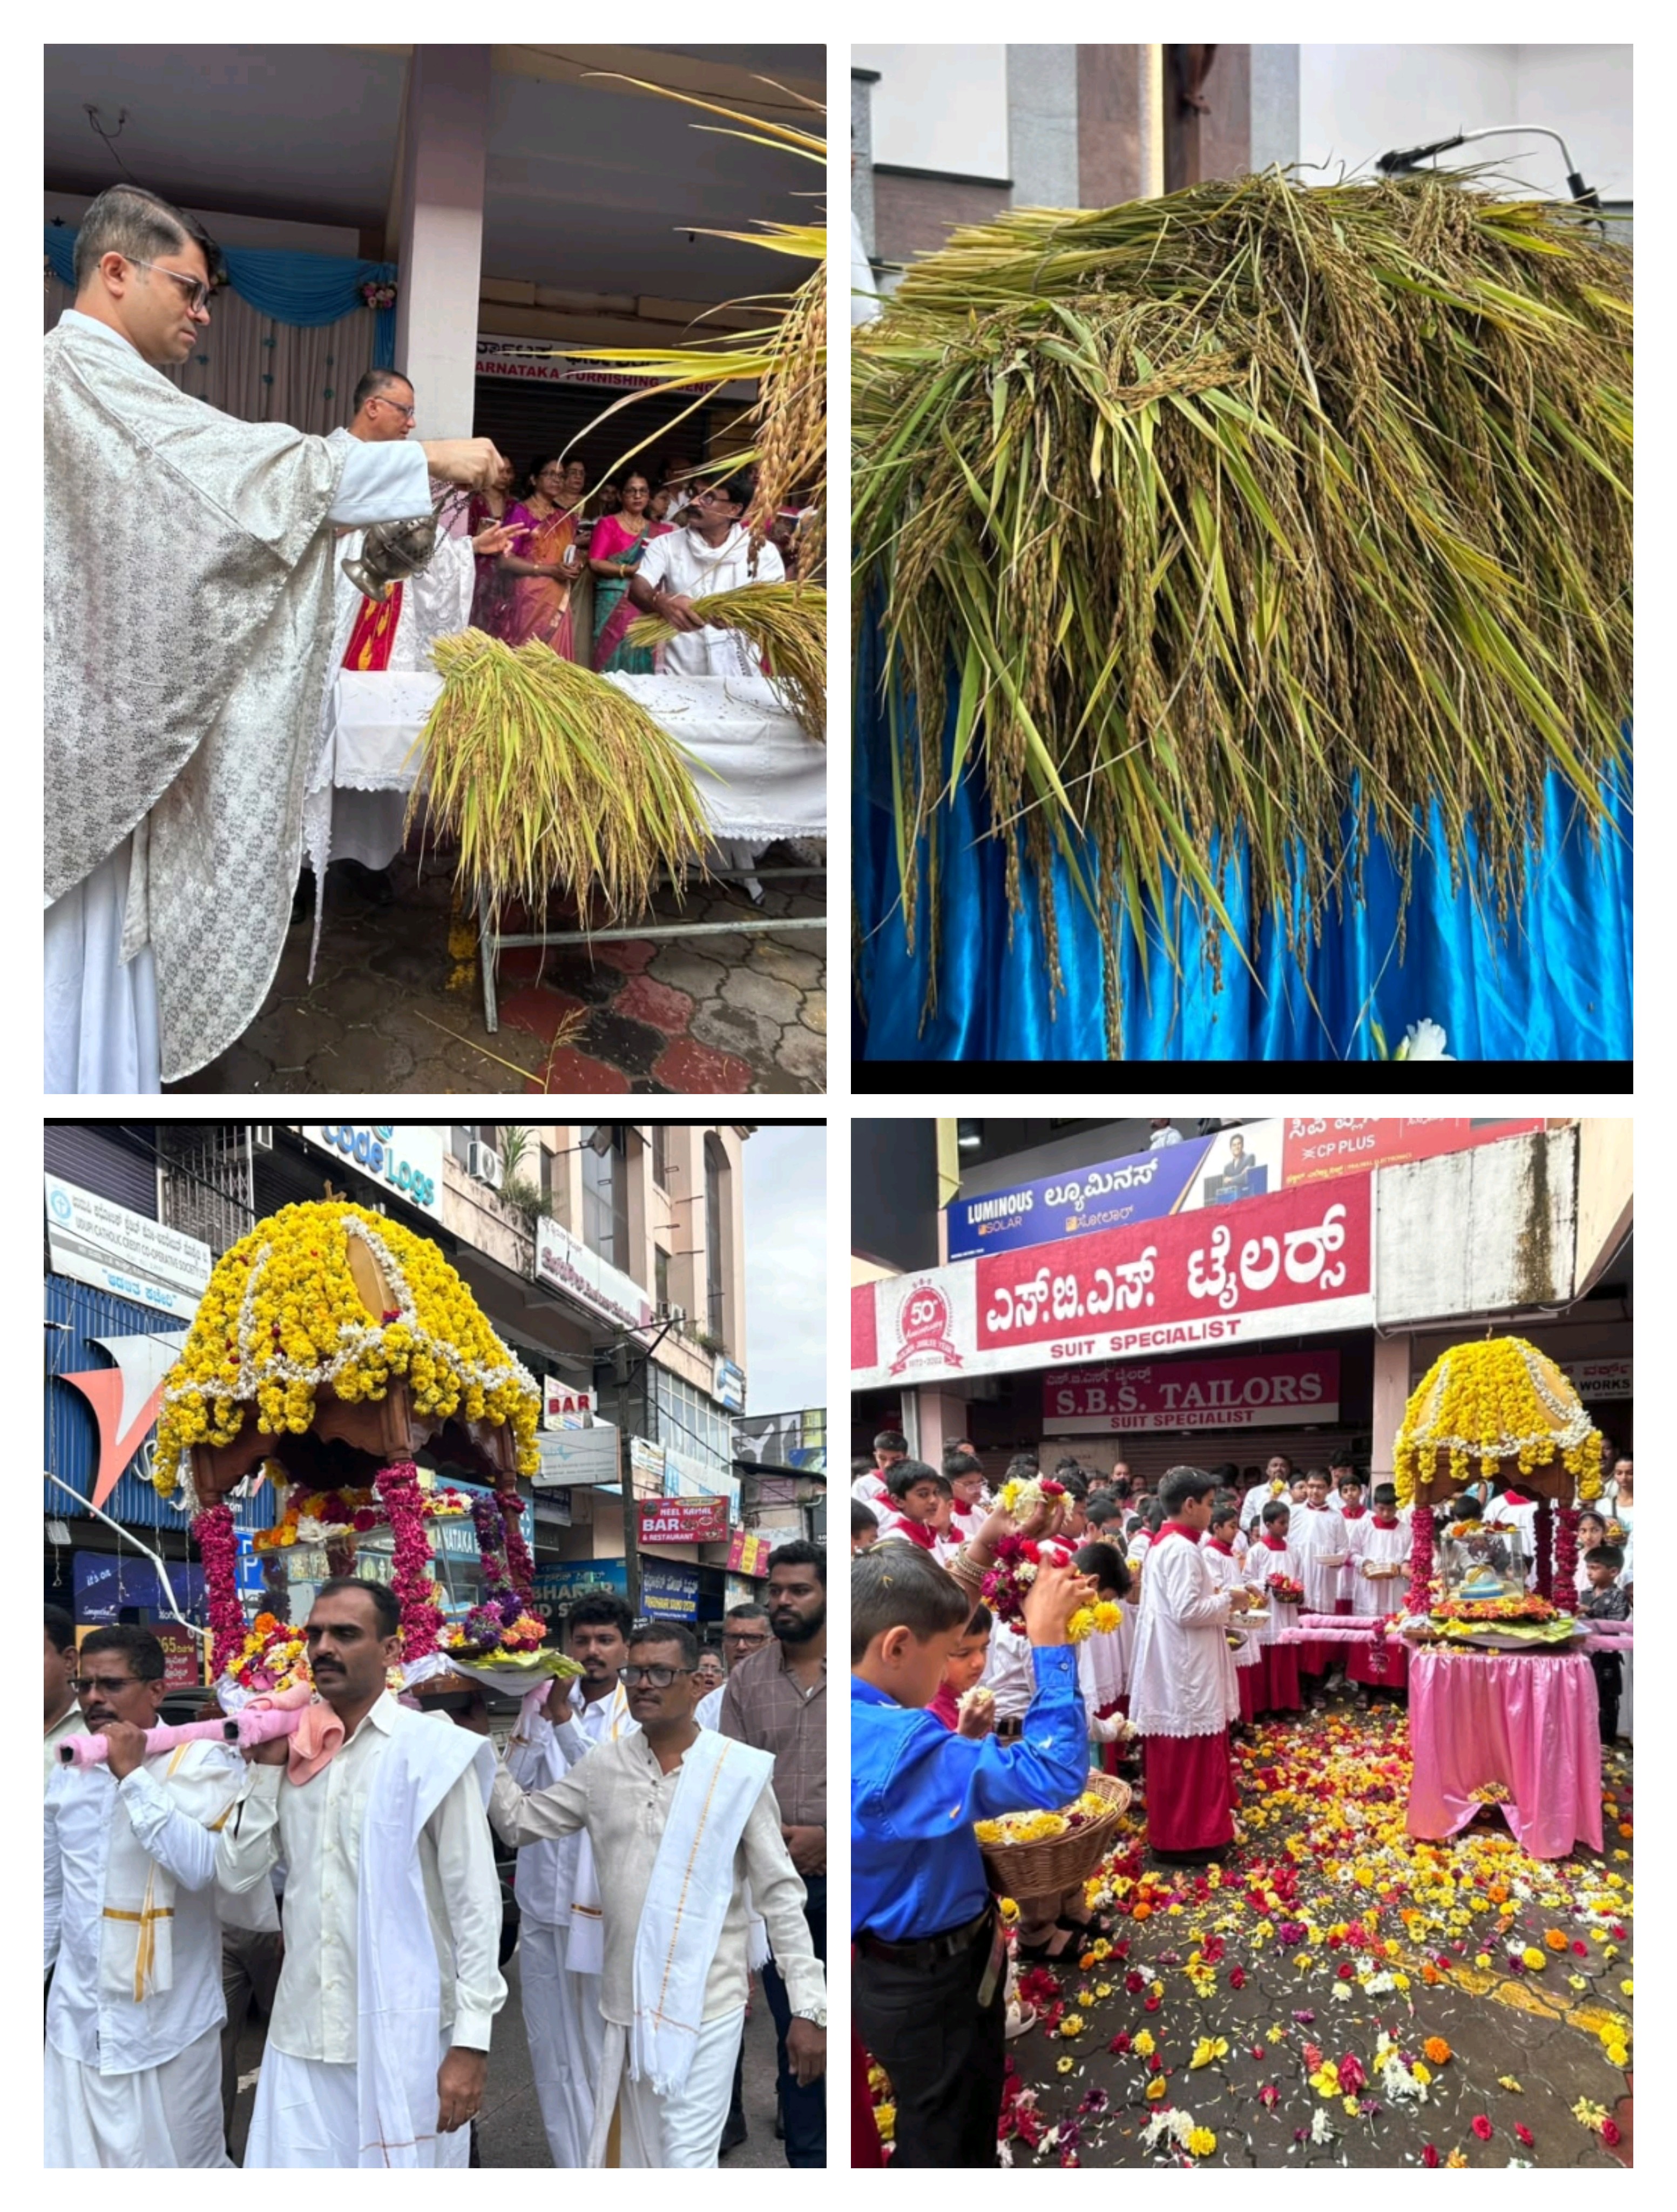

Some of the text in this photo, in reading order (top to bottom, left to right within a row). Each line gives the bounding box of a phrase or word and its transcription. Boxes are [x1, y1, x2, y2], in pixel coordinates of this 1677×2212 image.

[476, 361, 559, 379] ARNATAKA
[1316, 1134, 1376, 1158] CP PLUS
[386, 1148, 434, 1206] Logs
[968, 1190, 1033, 1224] LUMINOUS
[985, 1216, 1023, 1233] SOLAR
[94, 1224, 123, 1246] CATHOLIC
[123, 1236, 141, 1255] CREDIT
[1050, 1319, 1241, 1359] SUIT SPECIALIST
[1056, 1372, 1323, 1415] S.B.S. TAILORS
[1580, 1378, 1631, 1391] WORKS
[549, 1394, 590, 1414] BAR
[1110, 1410, 1255, 1429] SUIT SPECIALIST
[660, 1507, 713, 1516] NEEL KAMAL
[643, 1519, 680, 1532] BAR
[159, 1636, 177, 1653] 65
